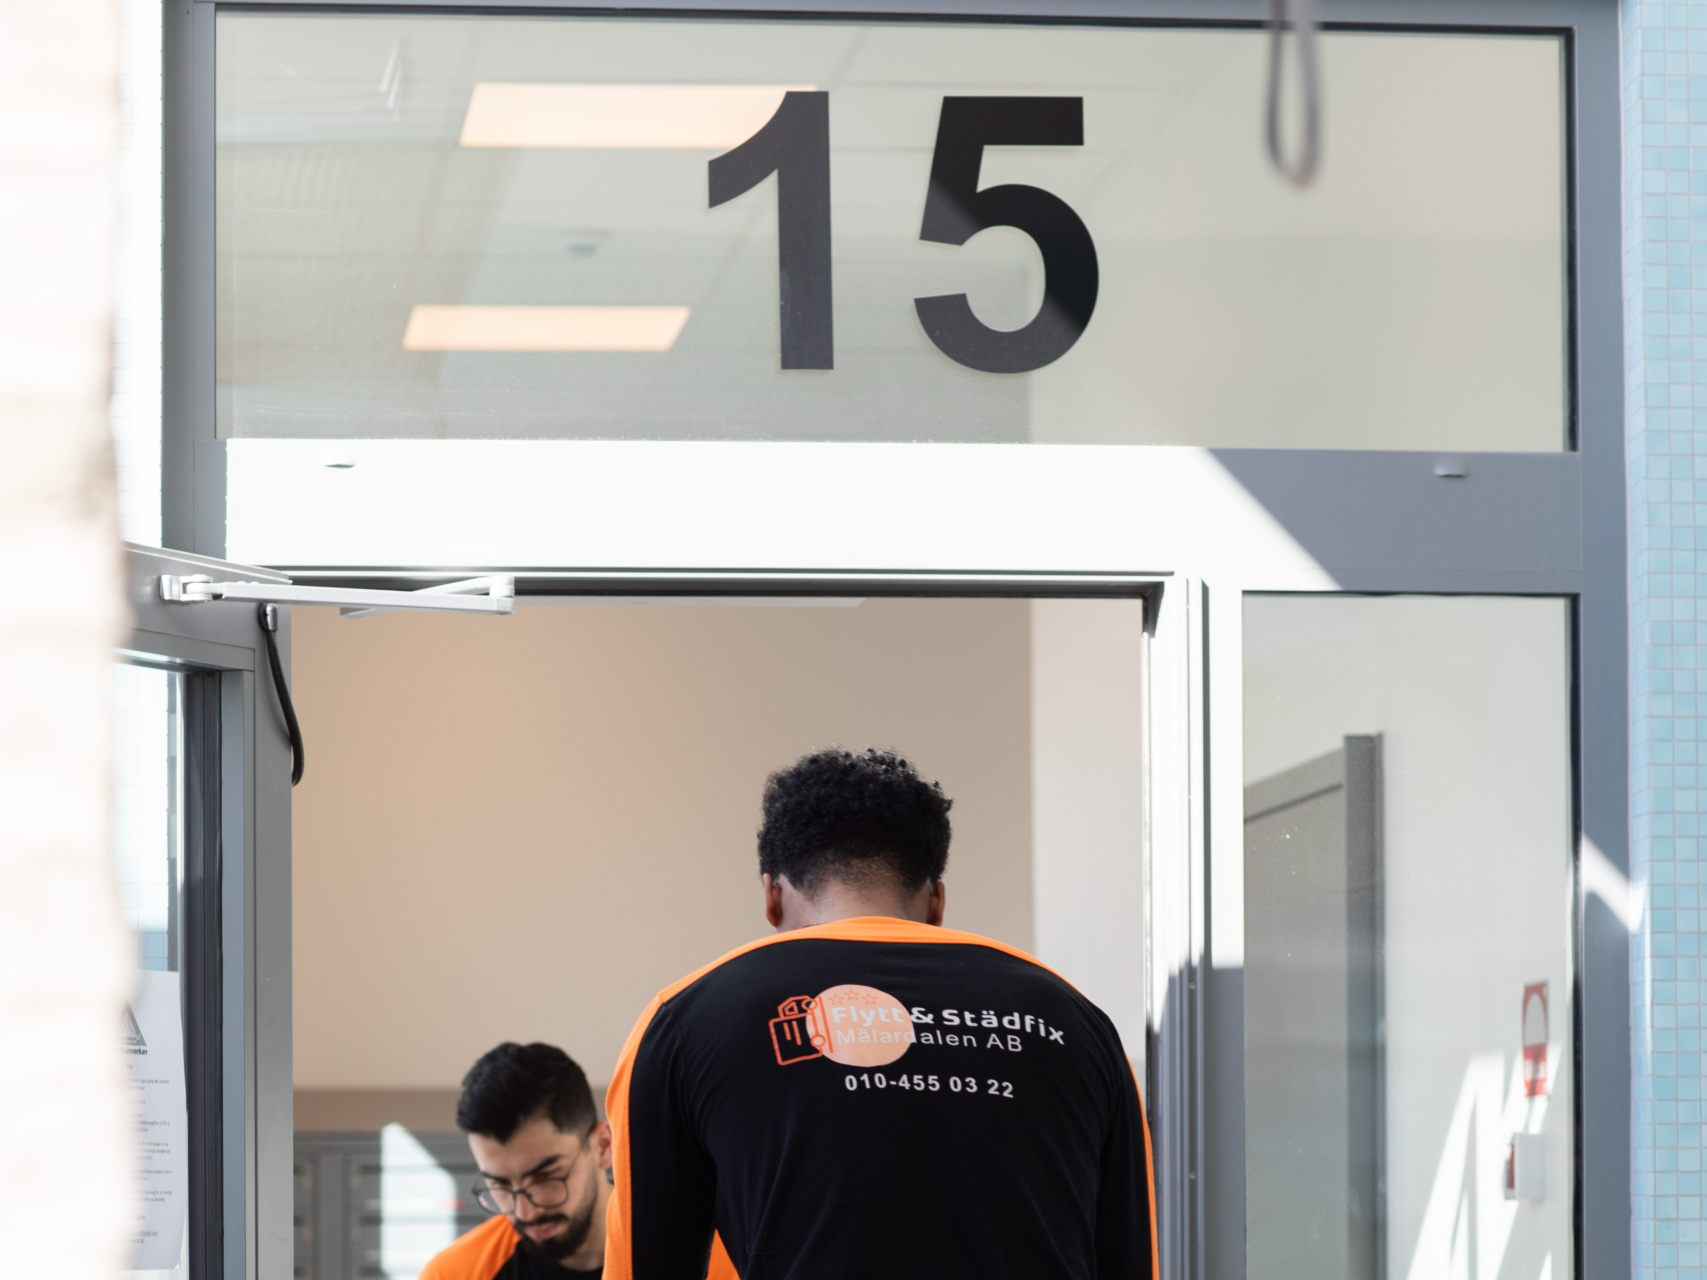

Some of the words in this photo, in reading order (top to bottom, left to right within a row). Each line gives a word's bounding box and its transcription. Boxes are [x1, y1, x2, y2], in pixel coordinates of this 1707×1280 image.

[708, 90, 1099, 374] 15
[831, 1005, 905, 1027] Flytt
[910, 1007, 934, 1024] &
[941, 1009, 1064, 1045] Städfix
[835, 1027, 977, 1047] Mälardalen
[986, 1033, 1022, 1052] AB
[845, 1073, 940, 1091] 010-455
[949, 1076, 978, 1093] 03
[987, 1079, 1014, 1098] 22
